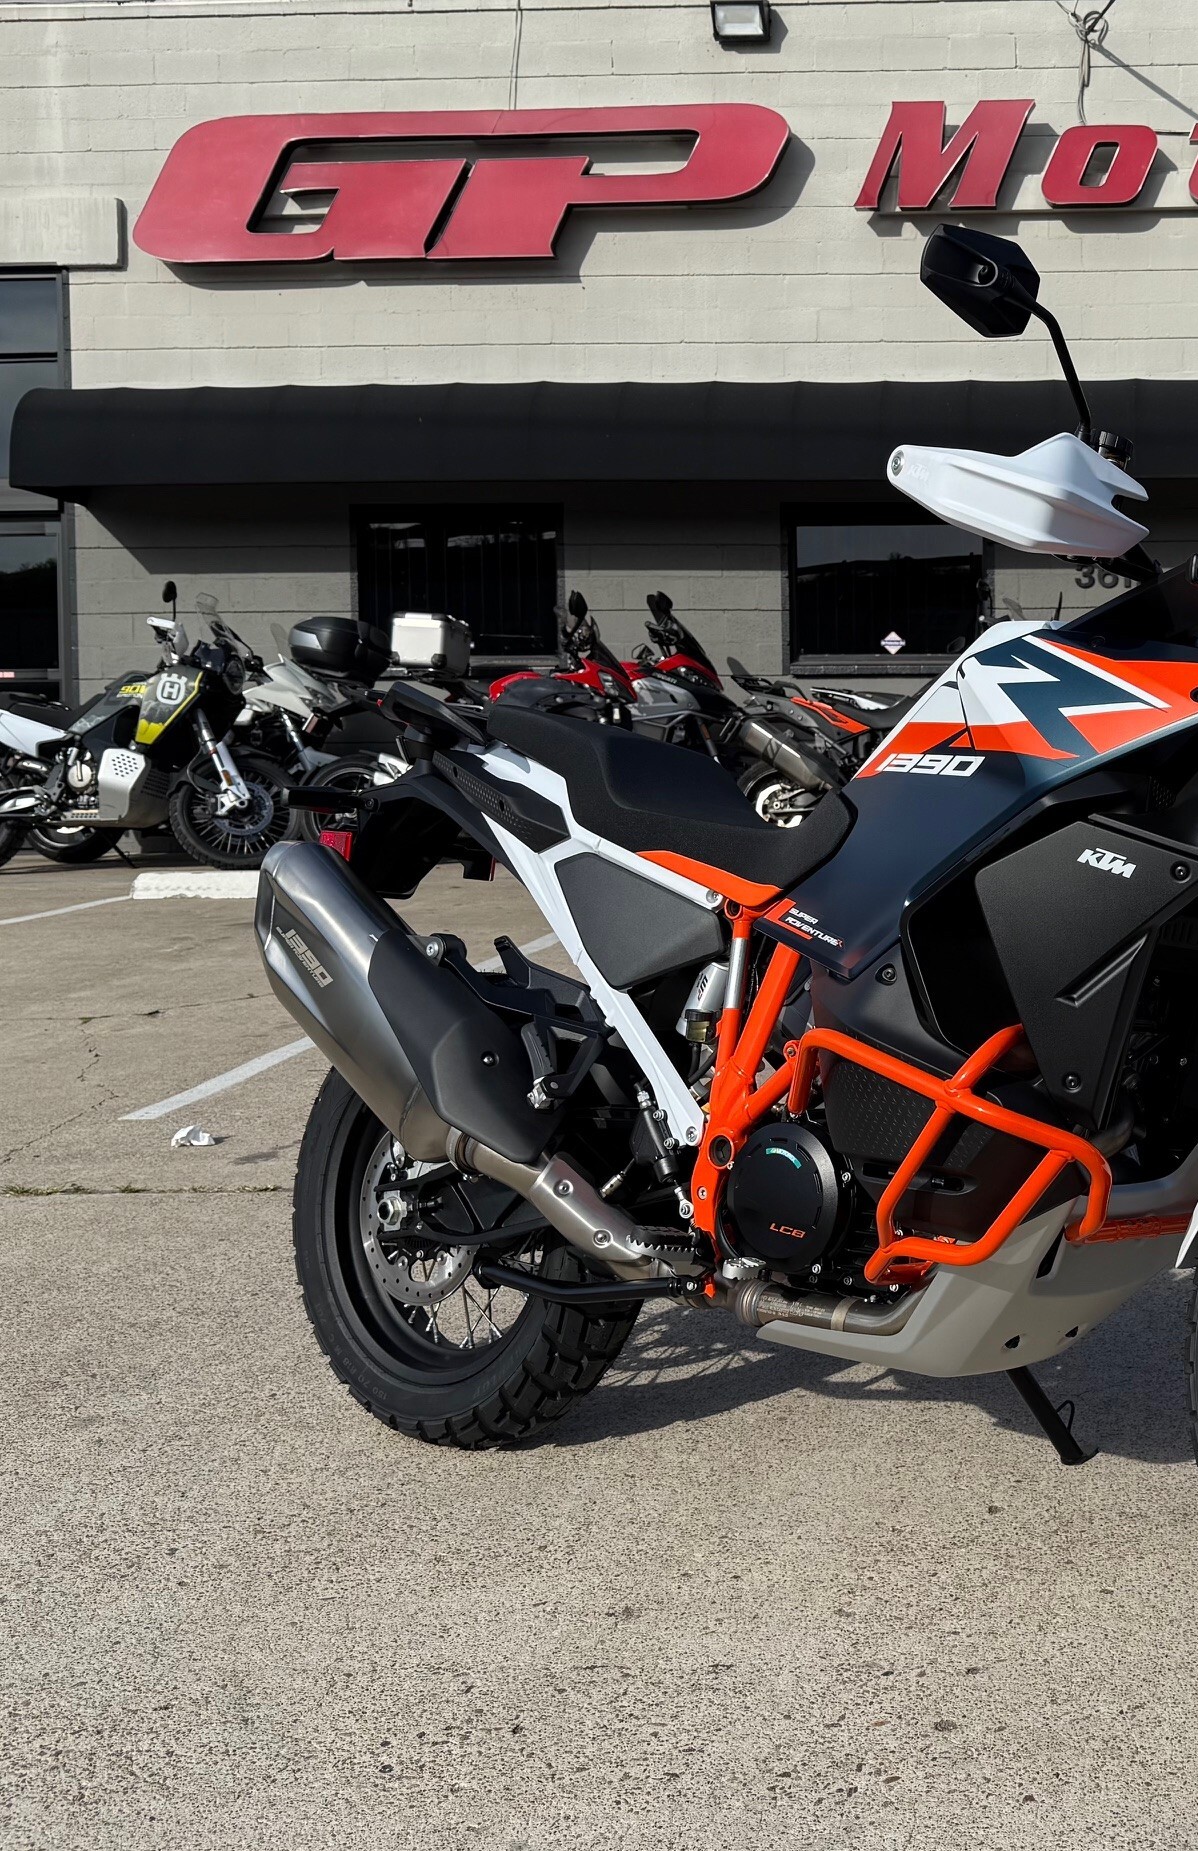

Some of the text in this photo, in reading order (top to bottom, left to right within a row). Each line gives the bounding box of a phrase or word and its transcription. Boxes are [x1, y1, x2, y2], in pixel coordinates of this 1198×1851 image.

[133, 103, 789, 262] GP
[875, 753, 986, 777] 1390
[1076, 847, 1137, 879] KTM
[788, 907, 819, 925] SUPER
[285, 928, 334, 987] 1390
[769, 1222, 806, 1239] LC8
